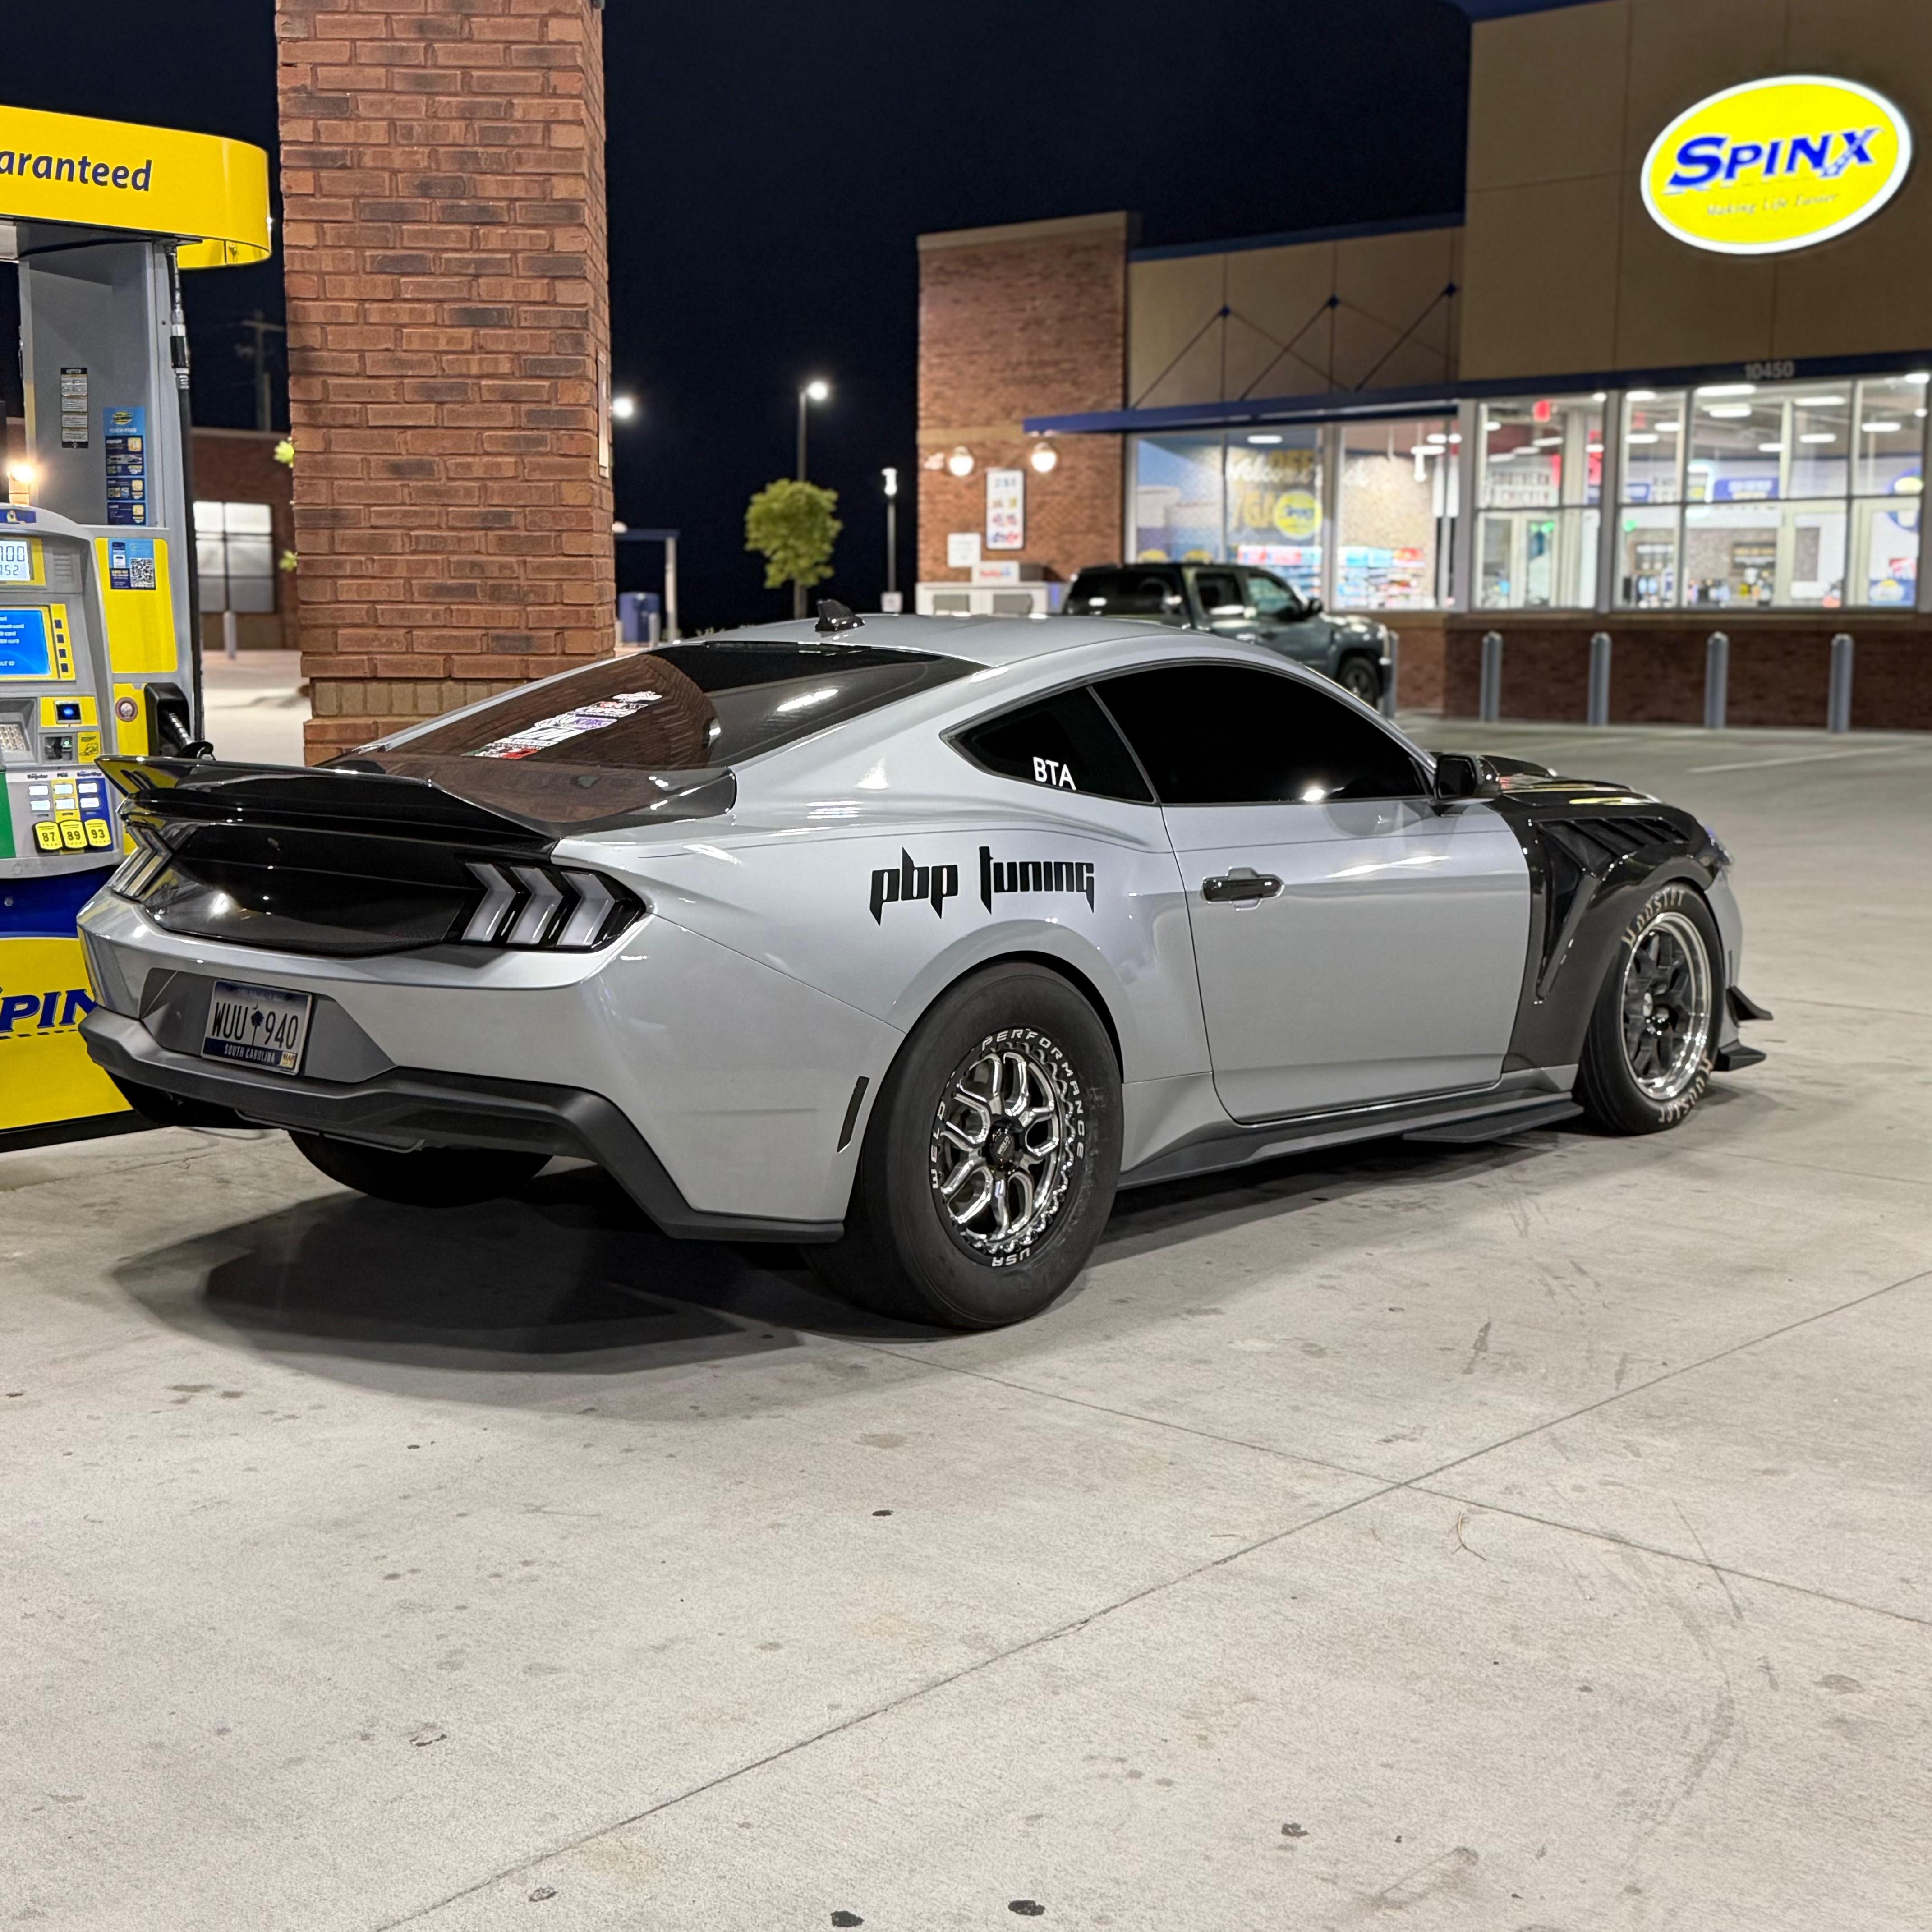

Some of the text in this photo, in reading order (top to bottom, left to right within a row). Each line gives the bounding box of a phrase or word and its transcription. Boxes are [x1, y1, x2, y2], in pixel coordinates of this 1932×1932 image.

[1667, 126, 1886, 187] SPINX
[1745, 359, 1795, 380] 10450
[1033, 756, 1076, 791] BTA
[41, 832, 55, 842] 87
[67, 830, 81, 841] 89
[91, 828, 105, 839] 93
[869, 846, 958, 926] pbp
[0, 987, 98, 1033] PIN
[212, 1001, 299, 1050] WUU 940
[224, 1044, 276, 1063] SOUTH CAROLINA
[981, 1028, 1085, 1159] PERFORMANCE
[992, 1247, 1031, 1267] USA
